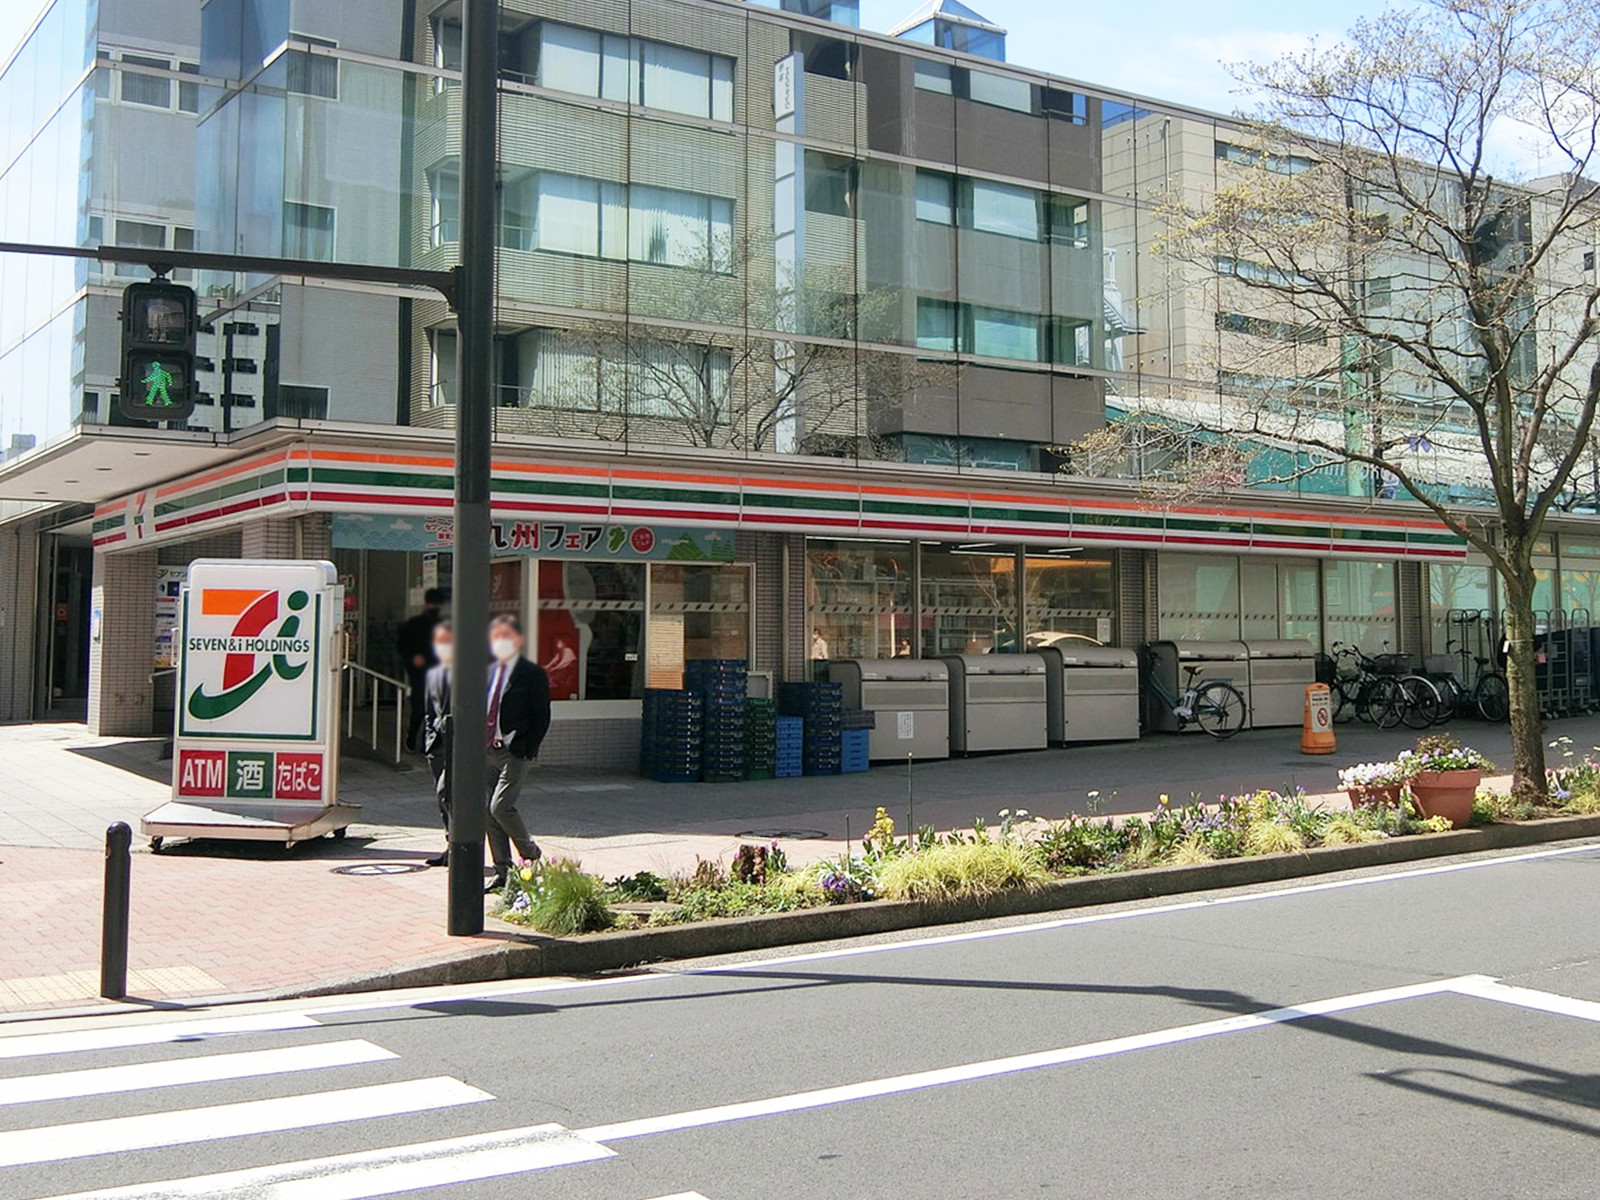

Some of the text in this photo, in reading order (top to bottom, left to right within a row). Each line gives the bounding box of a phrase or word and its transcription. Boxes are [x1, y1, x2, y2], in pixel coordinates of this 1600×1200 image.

[246, 639, 310, 653] HOLDINGS
[181, 758, 222, 789] ATM
[236, 759, 265, 790] 酒
[277, 761, 321, 792] たばこ
